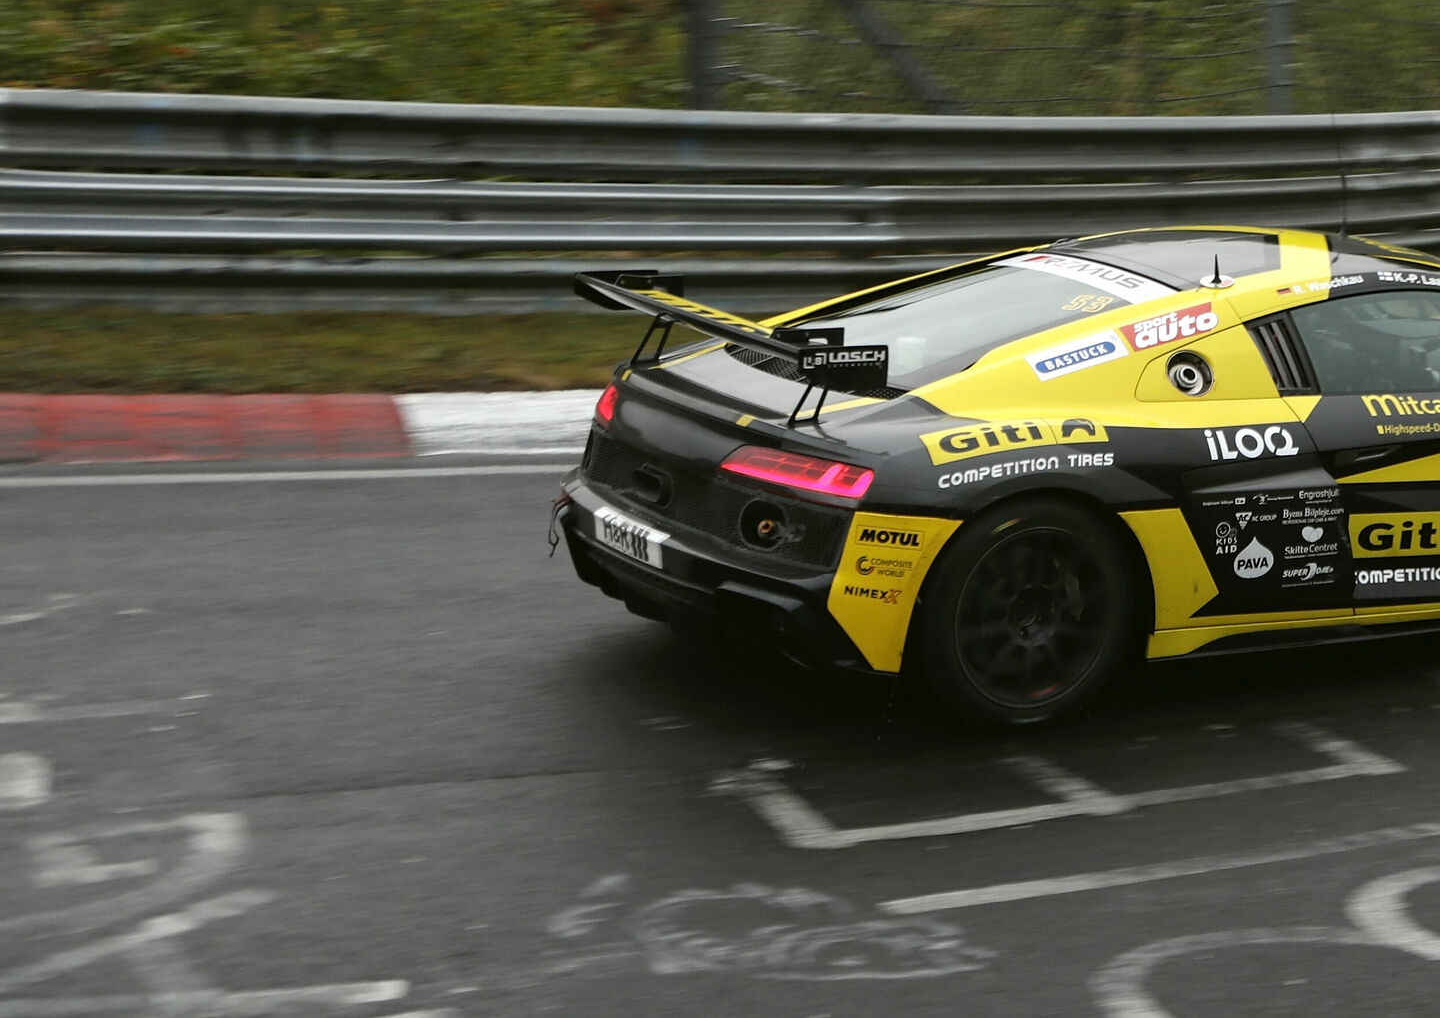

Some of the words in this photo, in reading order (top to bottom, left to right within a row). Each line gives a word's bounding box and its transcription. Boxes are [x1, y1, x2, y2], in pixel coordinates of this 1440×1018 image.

[1062, 293, 1114, 313] 53
[1133, 310, 1179, 333] sport
[1134, 311, 1219, 350] auto
[1045, 341, 1108, 372] BASTUCK
[938, 421, 1043, 456] Giti
[937, 455, 1060, 490] COMPETITION
[1067, 452, 1115, 468] TIRES
[860, 529, 920, 547] MOTUL
[1215, 537, 1238, 546] KIDS
[1215, 545, 1238, 556] AID
[1237, 556, 1269, 571] PAVA
